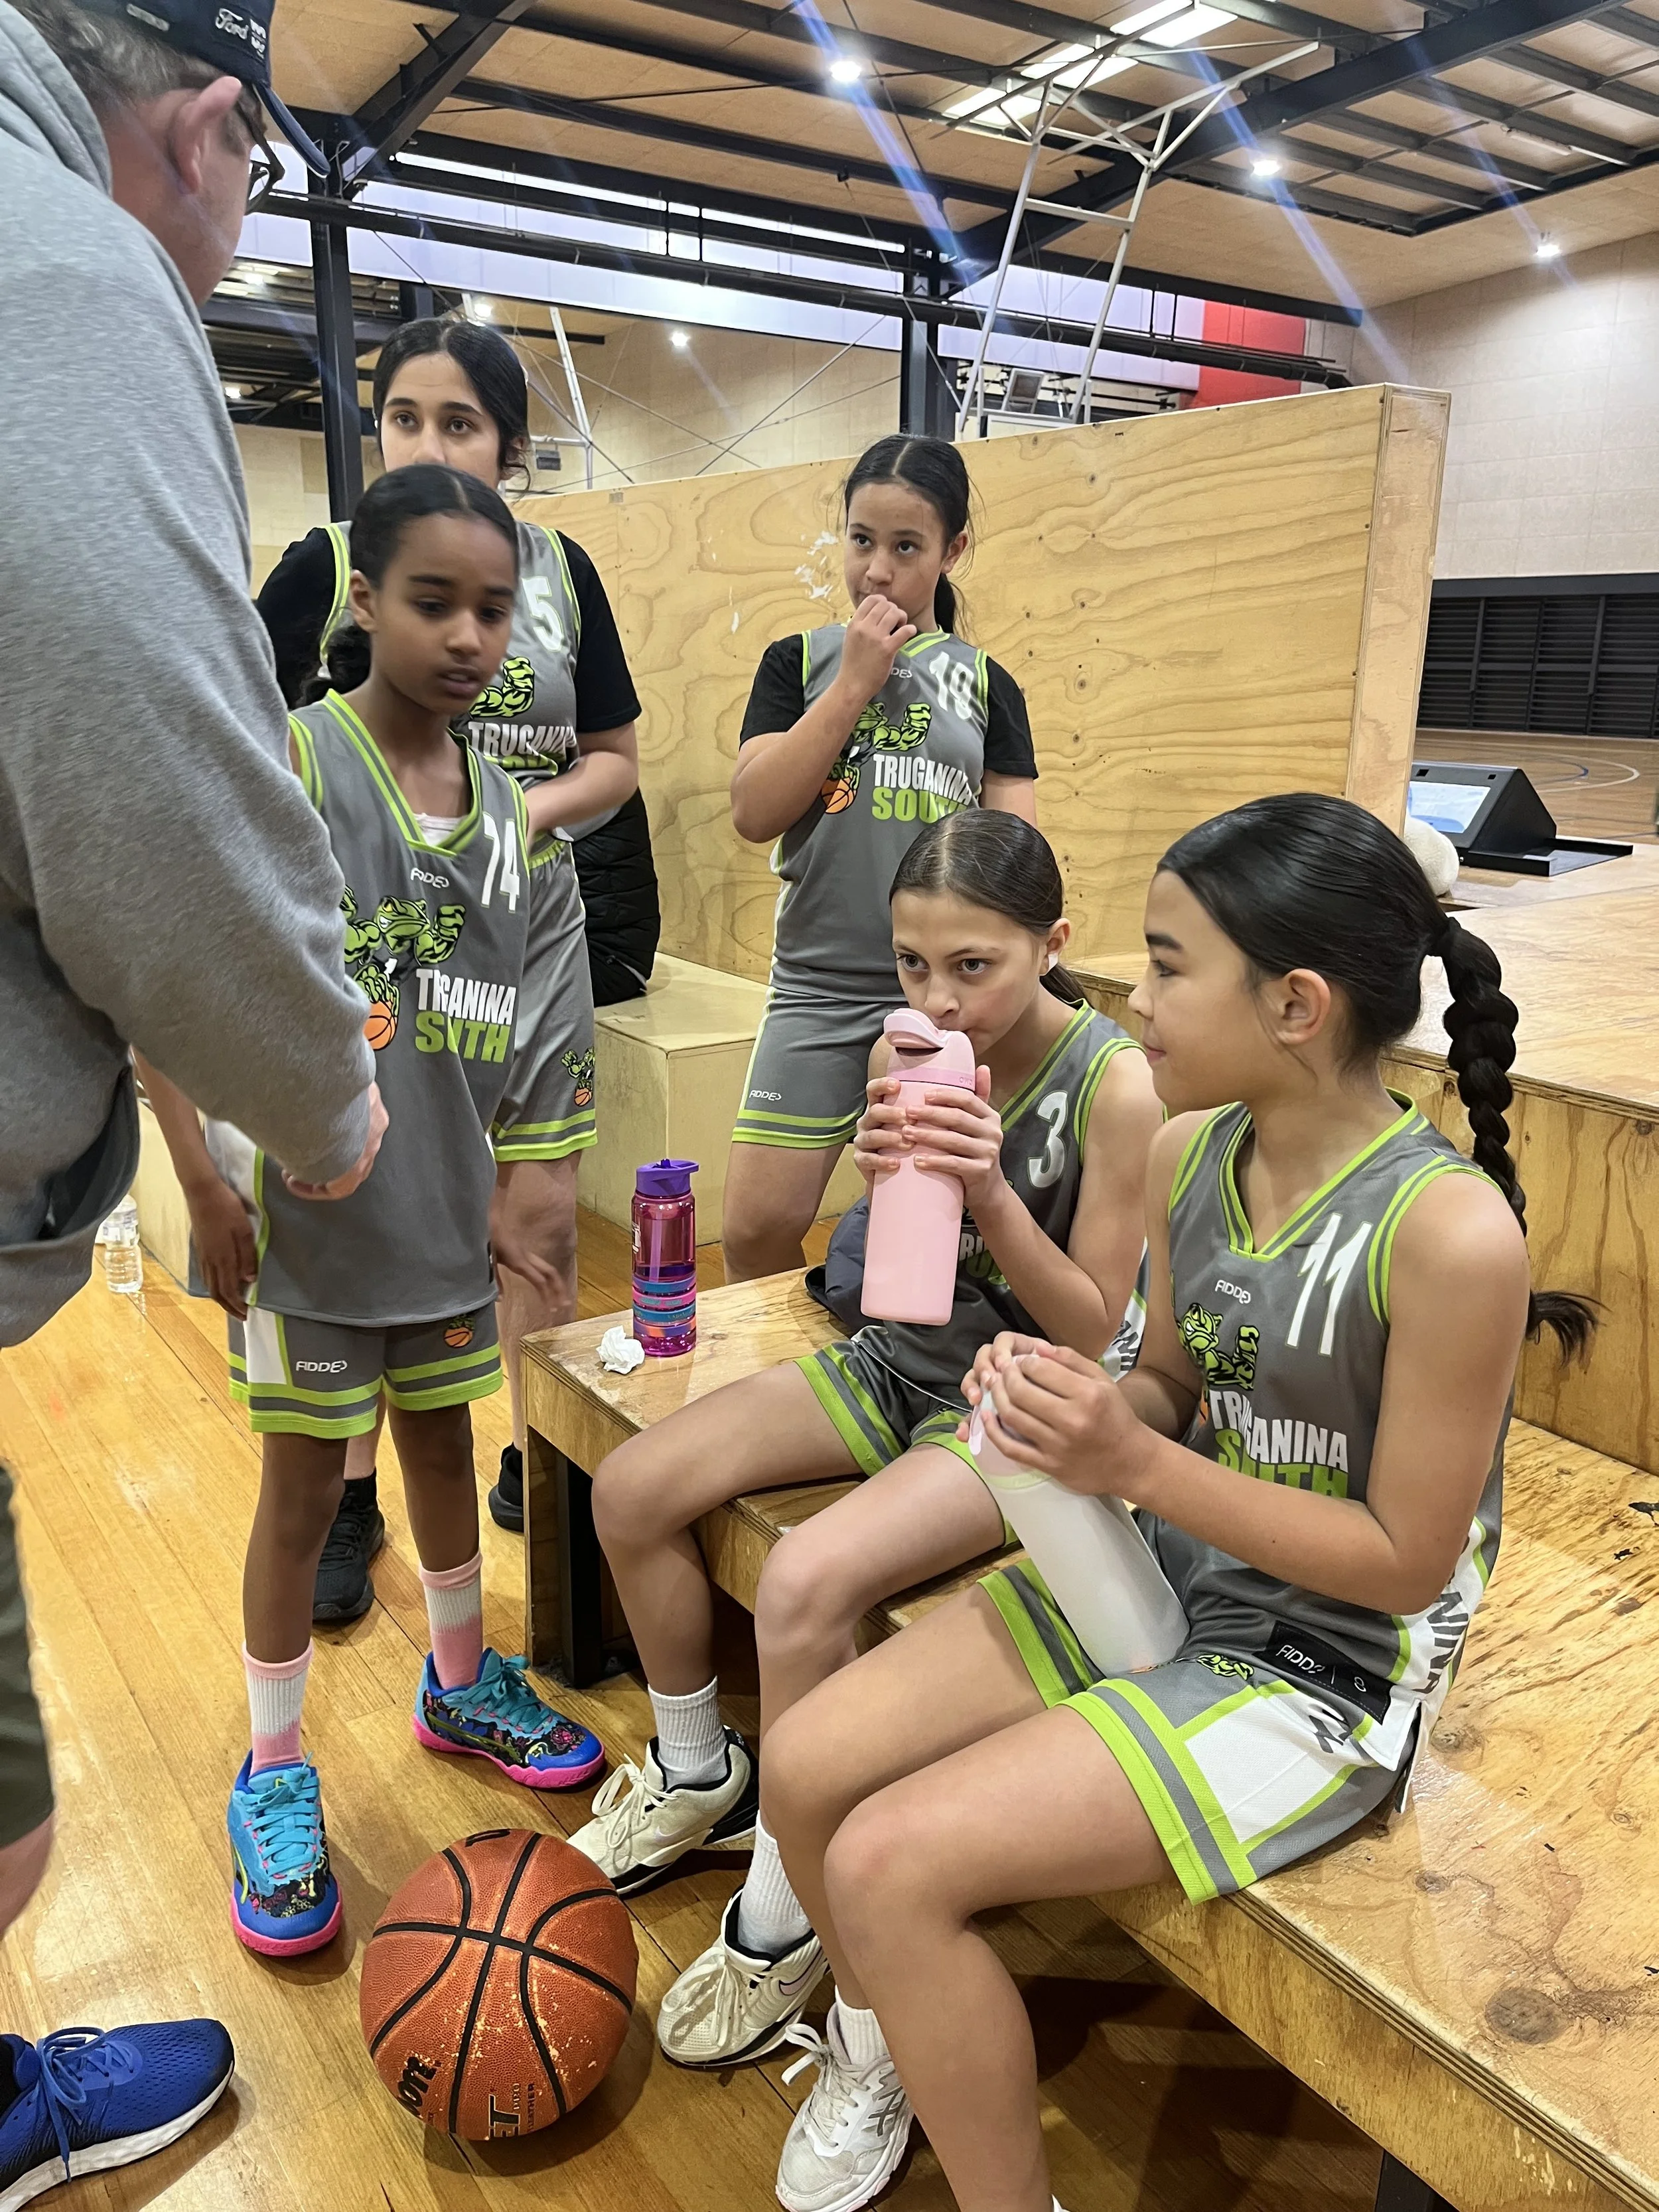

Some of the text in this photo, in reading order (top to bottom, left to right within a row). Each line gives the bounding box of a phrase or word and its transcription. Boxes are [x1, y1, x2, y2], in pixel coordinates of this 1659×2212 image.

[216, 8, 249, 40] Ford
[521, 575, 564, 652] 5
[873, 754, 973, 806] TRUGANINA
[481, 811, 521, 915] 74
[1027, 1089, 1068, 1190] 3
[1284, 1212, 1374, 1358] 11
